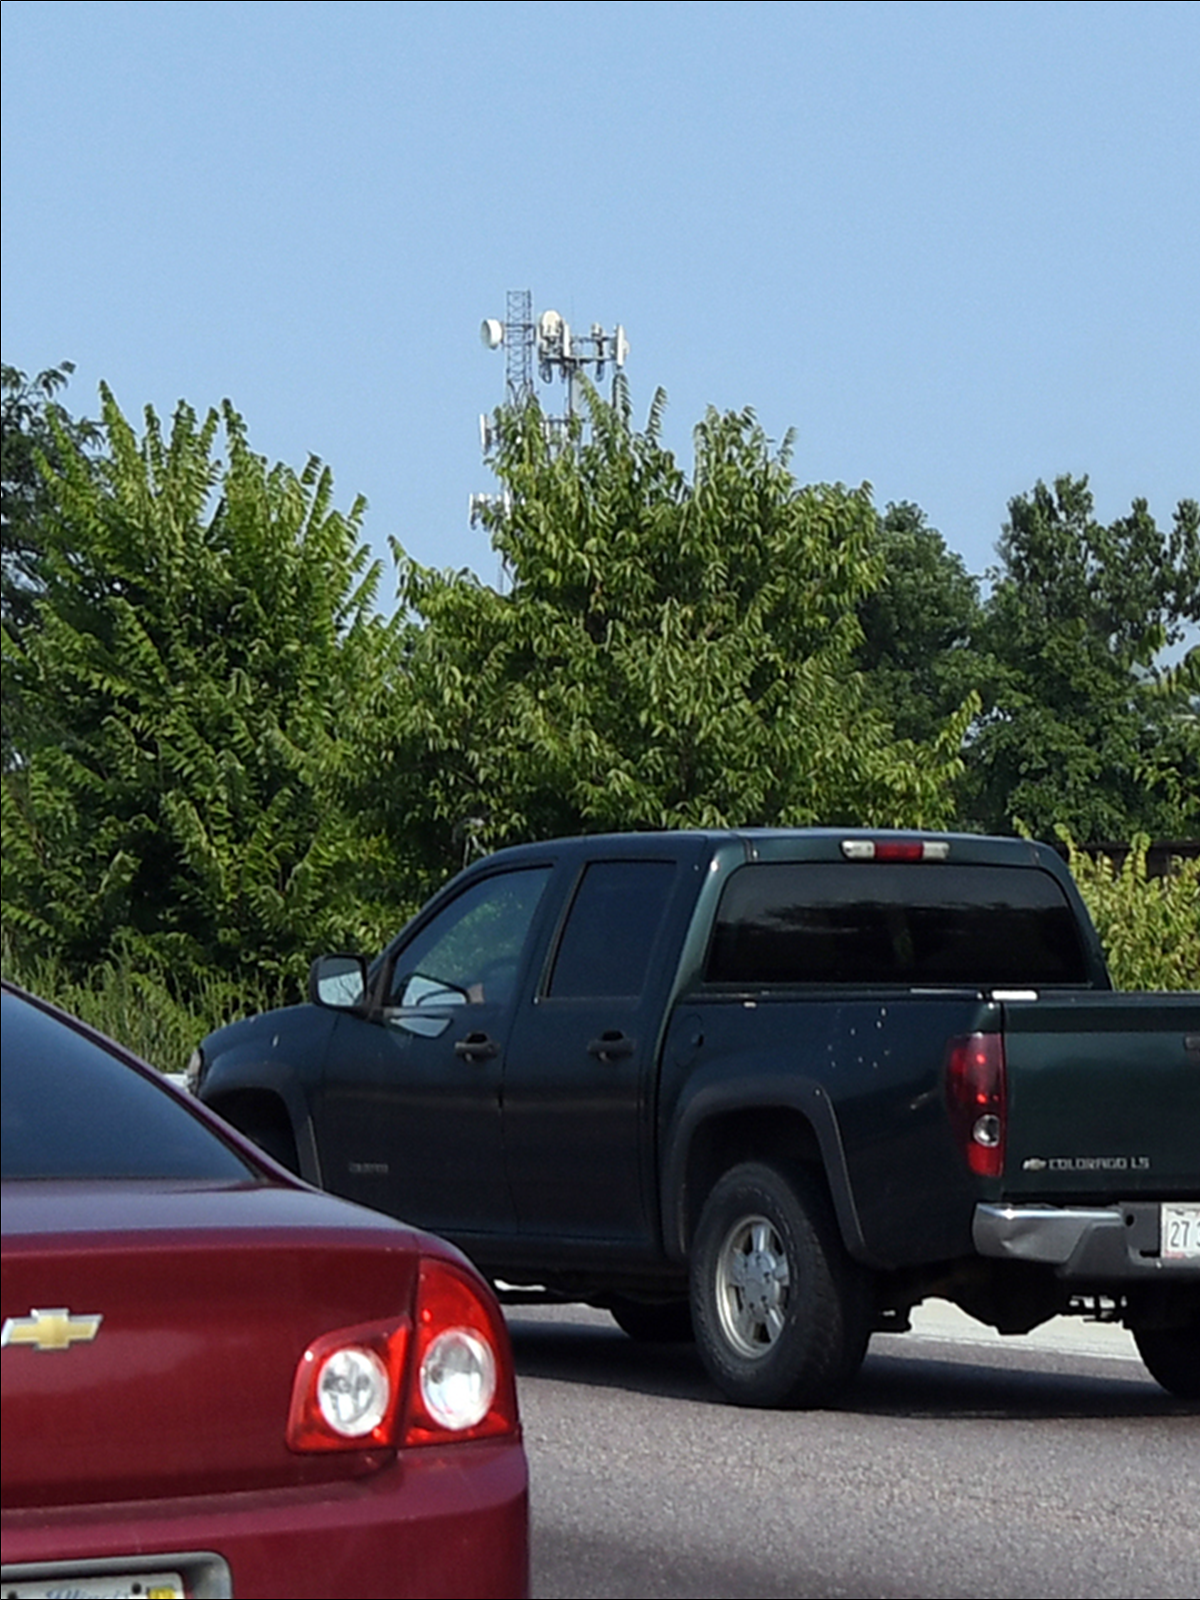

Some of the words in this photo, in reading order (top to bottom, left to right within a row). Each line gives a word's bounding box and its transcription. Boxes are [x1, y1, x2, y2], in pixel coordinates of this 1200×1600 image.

[1048, 1158, 1128, 1170] COLORADO
[1130, 1157, 1150, 1169] LS
[1170, 1220, 1190, 1248] 27
